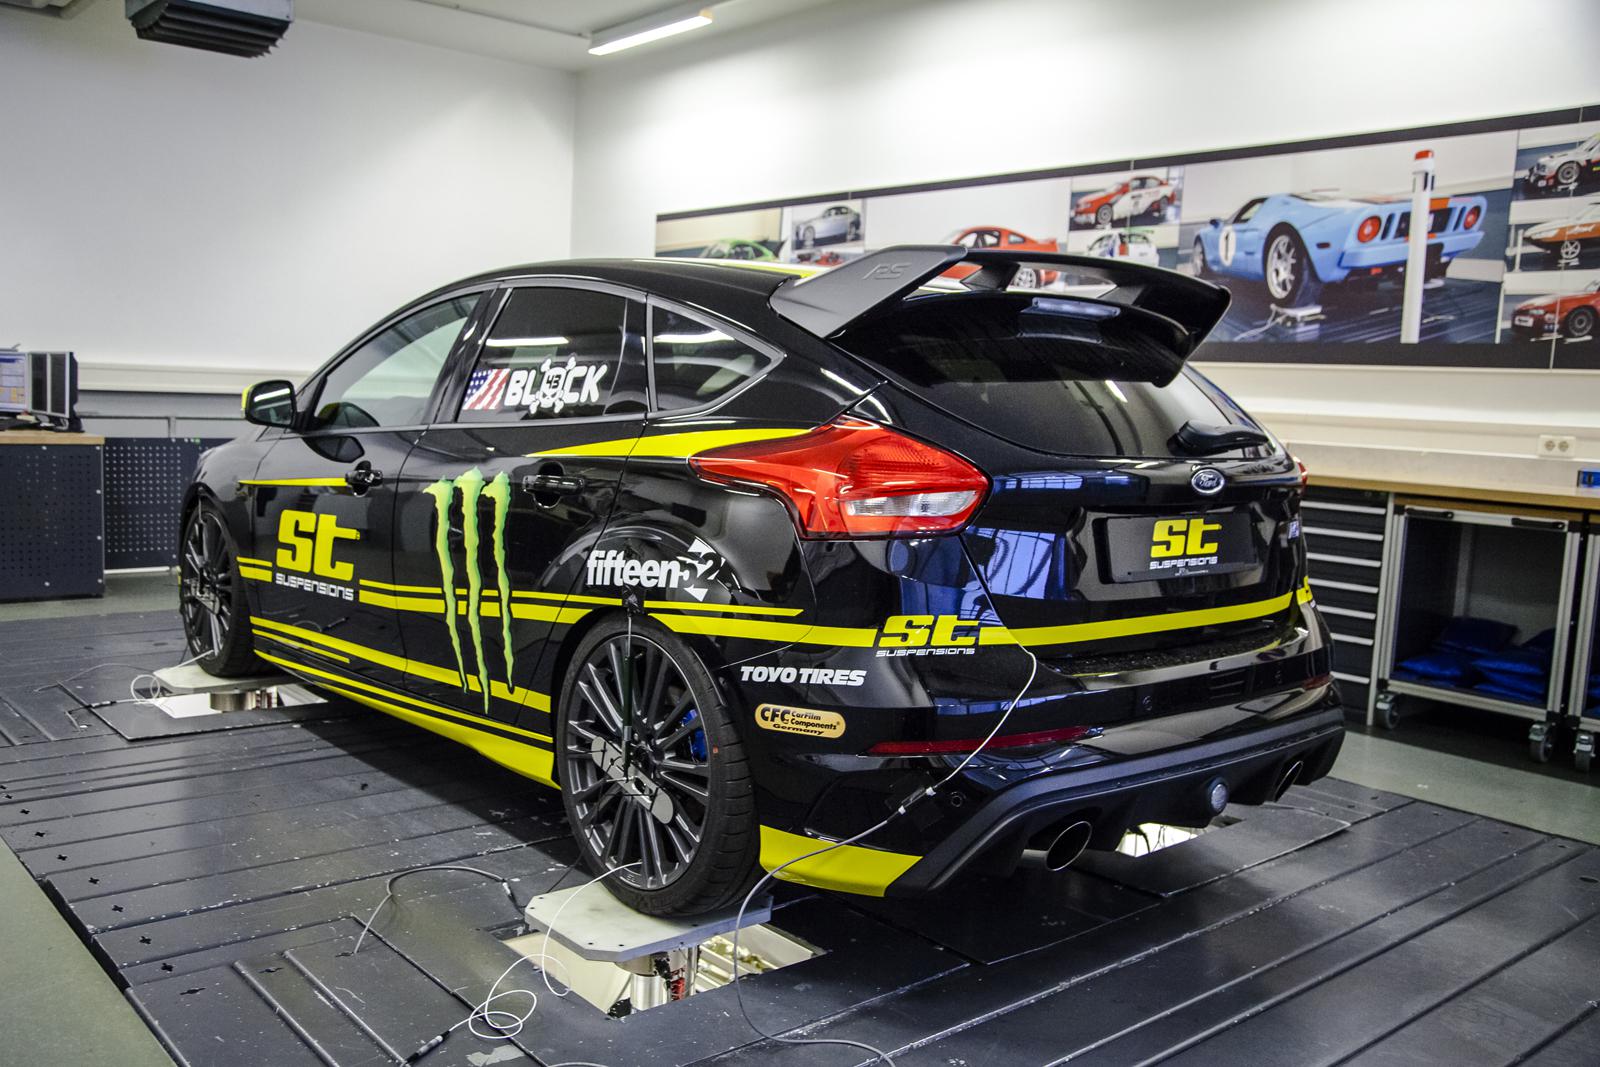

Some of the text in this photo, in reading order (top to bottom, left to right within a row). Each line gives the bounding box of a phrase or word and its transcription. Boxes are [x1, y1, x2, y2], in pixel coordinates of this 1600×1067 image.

[862, 263, 912, 280] RS
[504, 364, 608, 407] BLOCK
[546, 374, 561, 388] 43
[740, 665, 867, 687] TOYO TIRES
[760, 706, 791, 725] CFC
[773, 723, 825, 736] Germany
